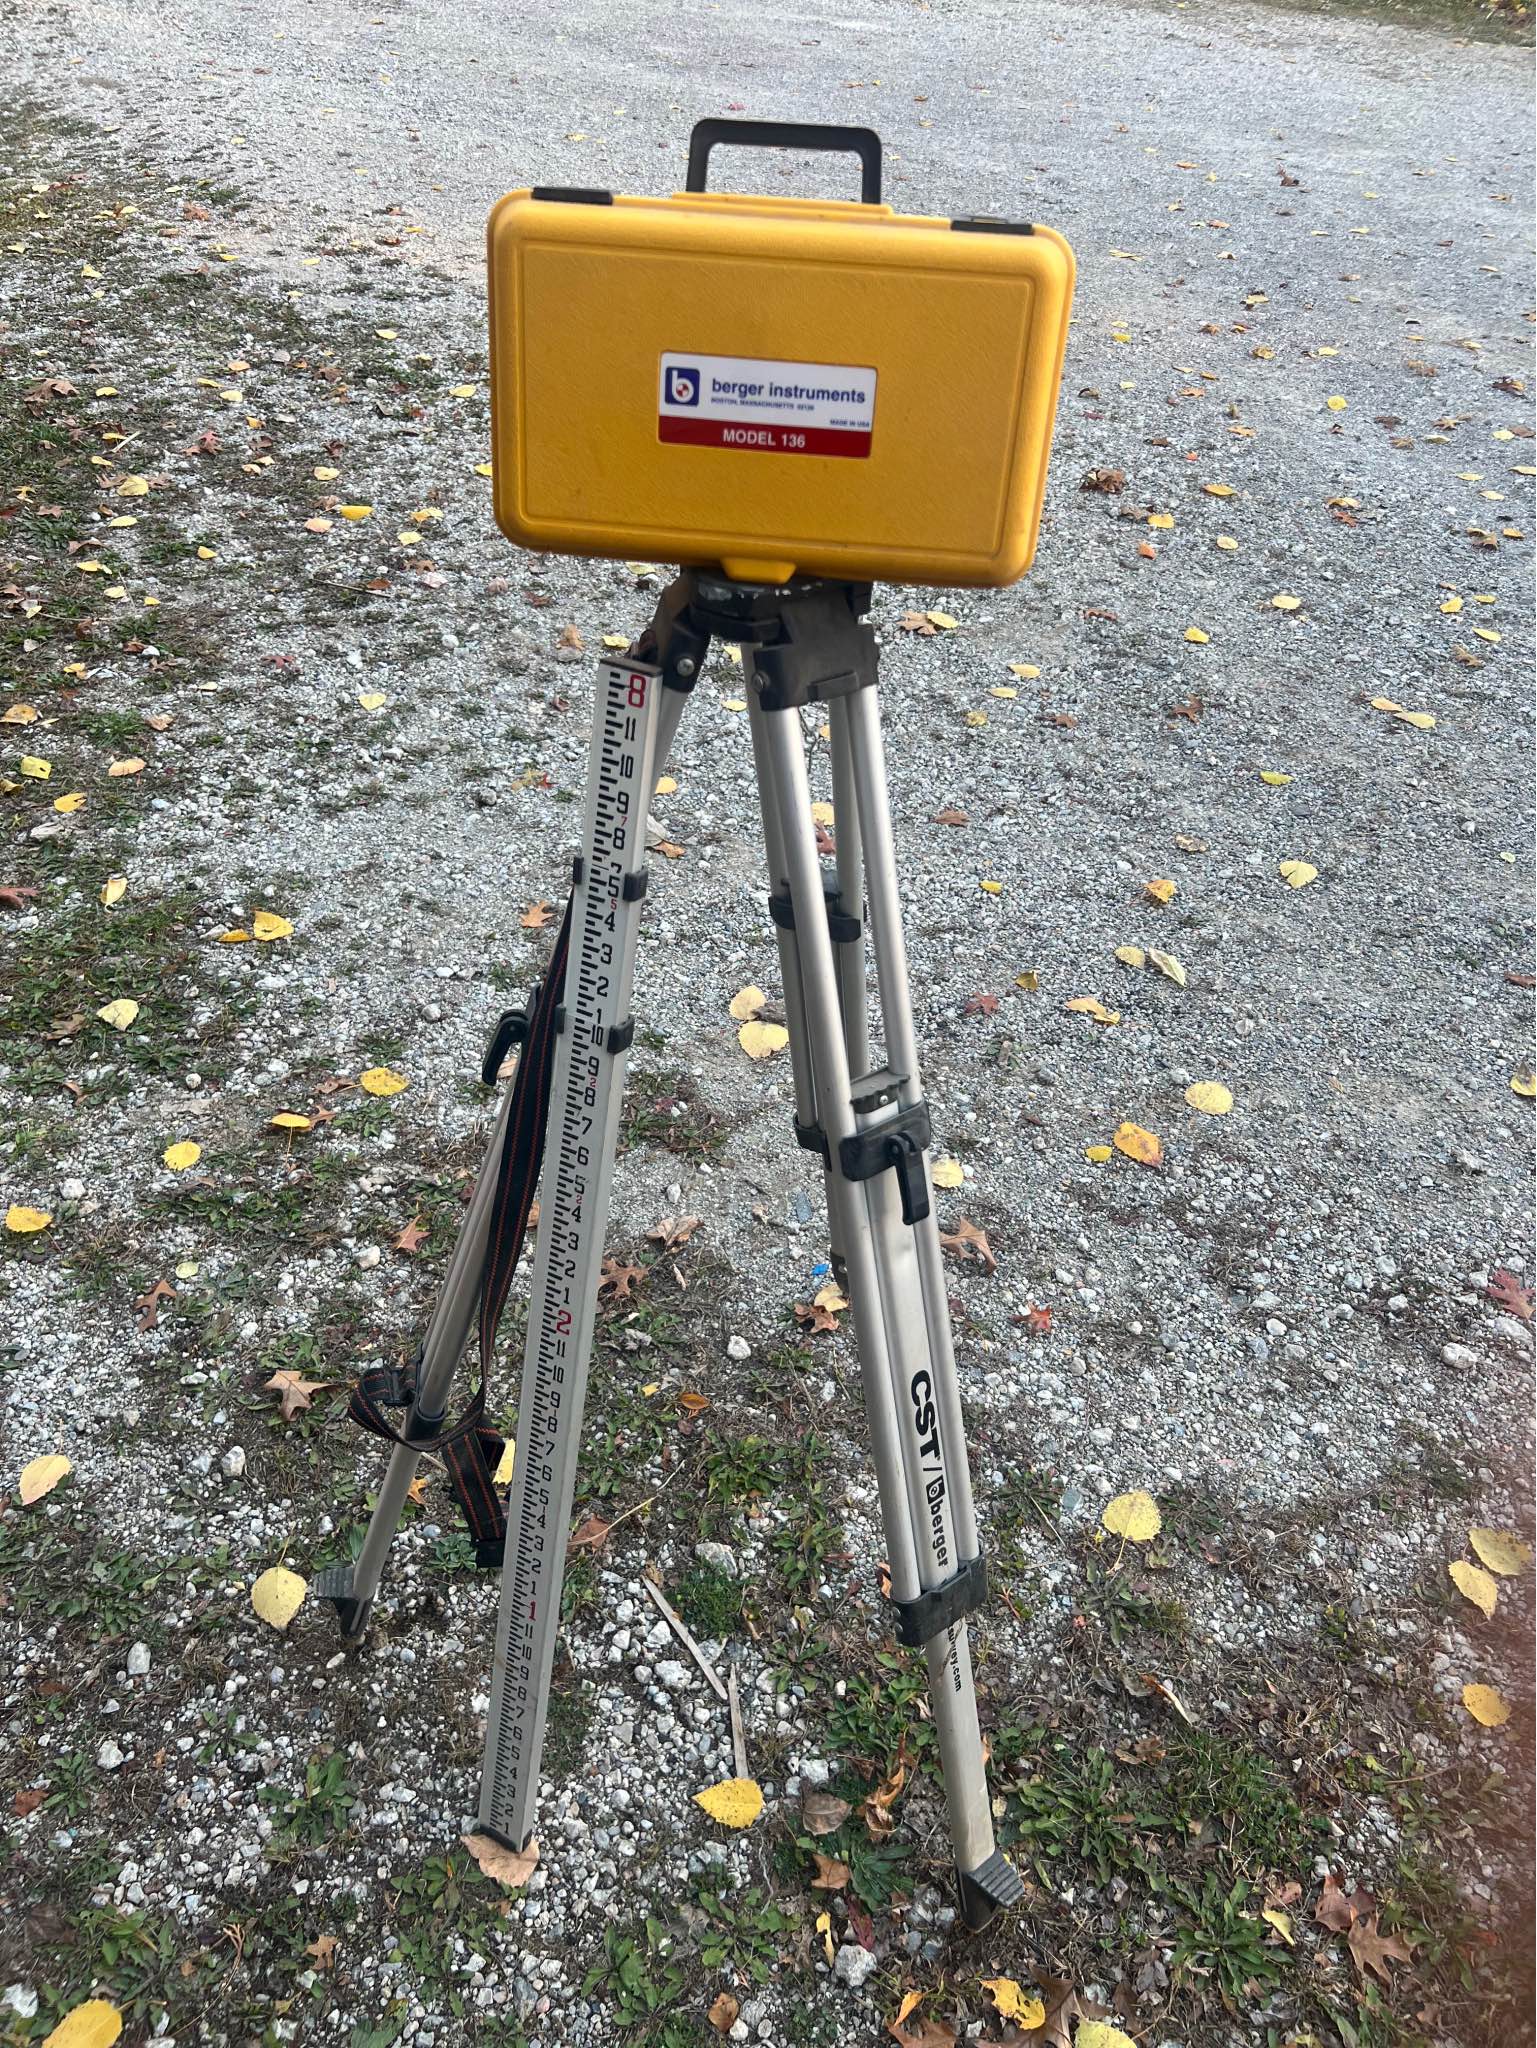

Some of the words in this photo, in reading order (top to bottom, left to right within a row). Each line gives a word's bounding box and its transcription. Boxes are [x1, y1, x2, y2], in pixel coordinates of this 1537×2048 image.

[712, 377, 764, 399] berger
[769, 381, 866, 404] instruments
[723, 428, 776, 446] MODEL
[781, 433, 806, 449] 136
[628, 674, 646, 708] 8
[624, 716, 637, 741] 11
[619, 753, 634, 779] 10
[616, 791, 630, 814] 9
[620, 816, 628, 828] 7
[612, 827, 626, 850] 8
[607, 874, 621, 898] 5
[610, 898, 617, 910] 5
[604, 912, 616, 932] 4
[600, 943, 613, 965] 3
[596, 975, 610, 998] 2
[596, 1008, 602, 1025] 1
[591, 1024, 604, 1047] 10
[588, 1056, 600, 1077] 9
[590, 1077, 596, 1088] 2
[584, 1087, 596, 1107] 8
[581, 1115, 593, 1136] 7
[577, 1146, 590, 1166] 6
[574, 1174, 586, 1195] 5
[576, 1194, 583, 1205] 2
[571, 1205, 582, 1223] 4
[567, 1231, 580, 1251] 3
[564, 1259, 576, 1278] 2
[563, 1287, 570, 1305] 1
[556, 1309, 572, 1336] 2
[556, 1339, 566, 1358] 11
[552, 1364, 565, 1384] 10
[550, 1390, 561, 1409] 9
[547, 1416, 558, 1434] 8
[545, 1440, 556, 1456] 7
[541, 1465, 553, 1482] 6
[911, 1369, 940, 1458] CST
[930, 1499, 948, 1567] berger
[538, 1488, 549, 1506] 5
[536, 1513, 546, 1529] 4
[534, 1535, 545, 1552] 3
[531, 1557, 542, 1575] 2
[530, 1580, 537, 1596] 1
[528, 1600, 536, 1622] 1
[524, 1623, 534, 1640] 11
[521, 1644, 532, 1661] 10
[947, 1627, 962, 1692] surey.com
[519, 1665, 530, 1681] 9
[517, 1685, 527, 1701] 8
[515, 1705, 525, 1719] 7
[512, 1725, 522, 1741] 6
[511, 1745, 521, 1761] 5
[509, 1765, 518, 1780] 4
[507, 1783, 517, 1799] 3
[504, 1802, 513, 1817] 2
[503, 1821, 510, 1835] 1
